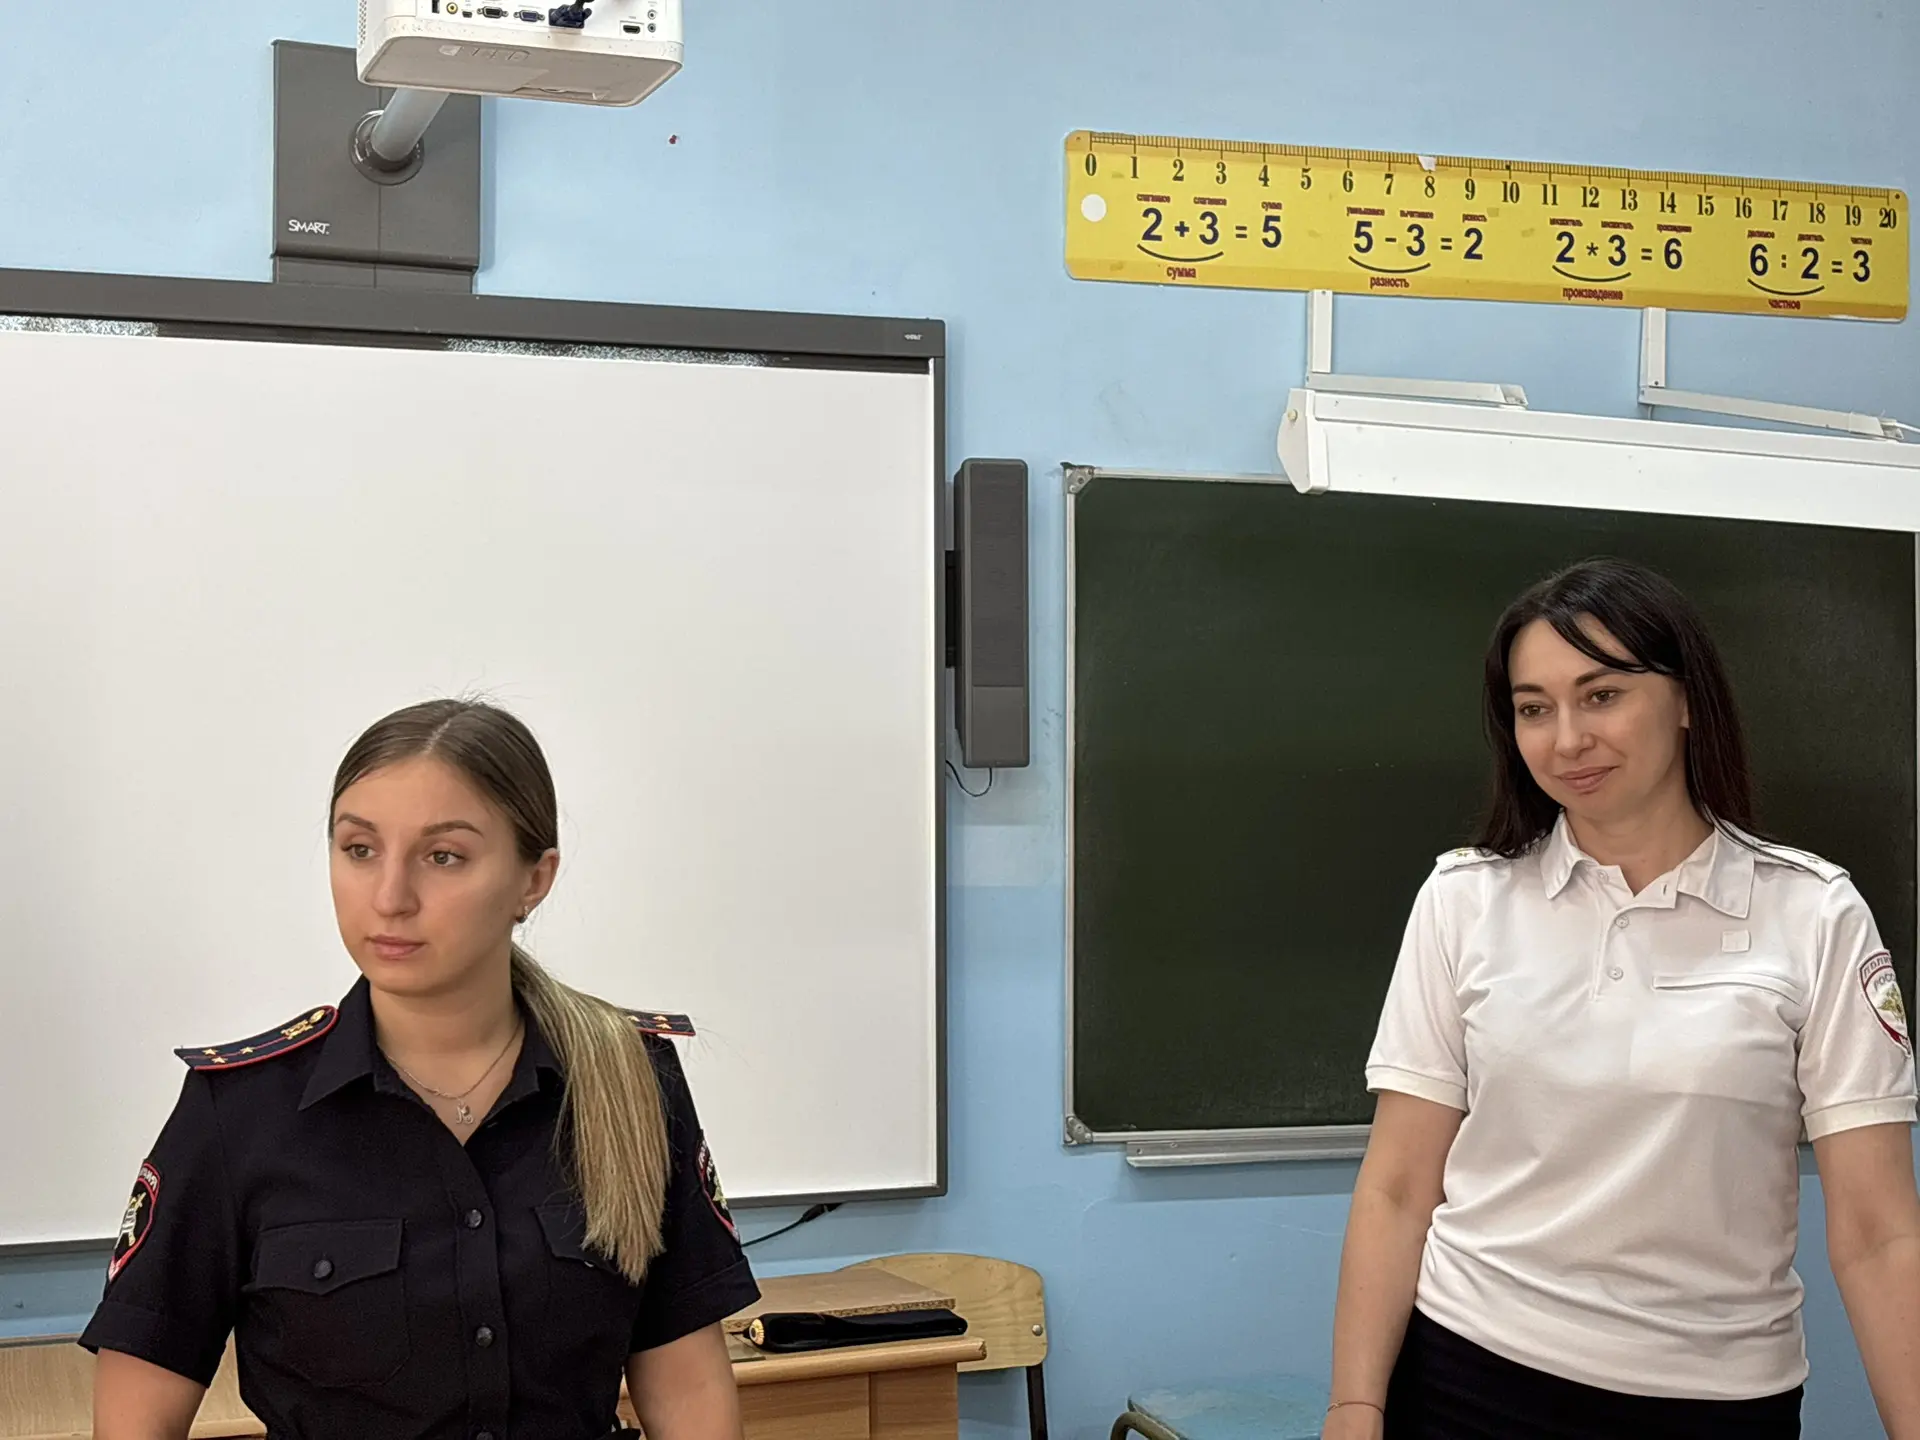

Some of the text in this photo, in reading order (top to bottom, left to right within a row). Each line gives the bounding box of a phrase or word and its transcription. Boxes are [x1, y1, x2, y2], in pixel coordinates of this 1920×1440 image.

[1085, 153, 1897, 229] 0 1 2 3 4 5 6 7 8 9 10 11 12 13 14 15 16 17 18 19 20
[288, 219, 330, 234] SMART
[1141, 207, 1163, 242] 2
[1199, 211, 1220, 245] 3
[1261, 214, 1282, 249] 5
[1353, 220, 1374, 254] 5
[1406, 223, 1426, 257] 3
[1463, 227, 1483, 261] 2
[1555, 230, 1575, 264] 2
[1607, 234, 1627, 267] 3
[1663, 237, 1683, 270] 6
[1749, 243, 1769, 277] 6
[1800, 247, 1820, 280] 2
[1852, 249, 1871, 283] 3
[1166, 266, 1197, 281] сумма
[1369, 276, 1410, 290] разность
